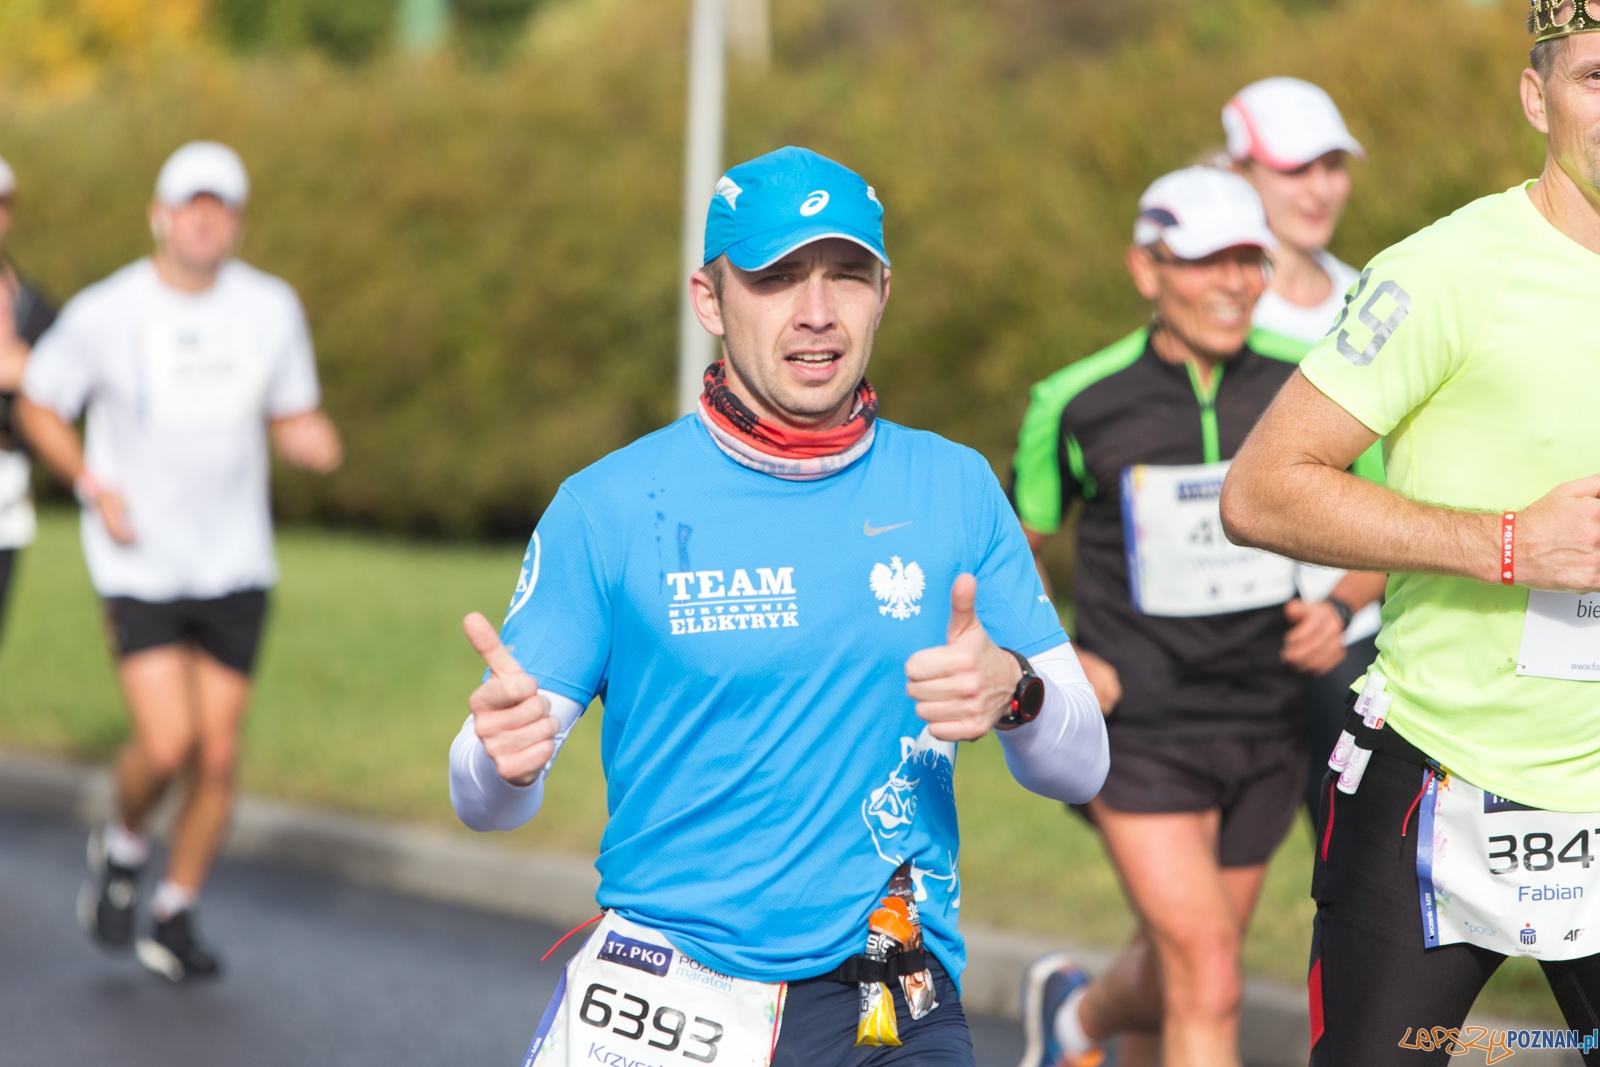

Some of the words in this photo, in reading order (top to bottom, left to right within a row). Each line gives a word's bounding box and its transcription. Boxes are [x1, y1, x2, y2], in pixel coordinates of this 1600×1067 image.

[1504, 525, 1513, 565] POLSKA
[667, 567, 796, 600] TEAM
[669, 603, 797, 617] HURTOWNIA
[670, 611, 799, 635] ELEKTRYK
[1488, 828, 1600, 875] 384
[1518, 884, 1584, 902] Fabian
[606, 940, 627, 957] 17.
[630, 947, 667, 967] PKO
[675, 966, 732, 992] maraton
[579, 983, 723, 1064] 6393
